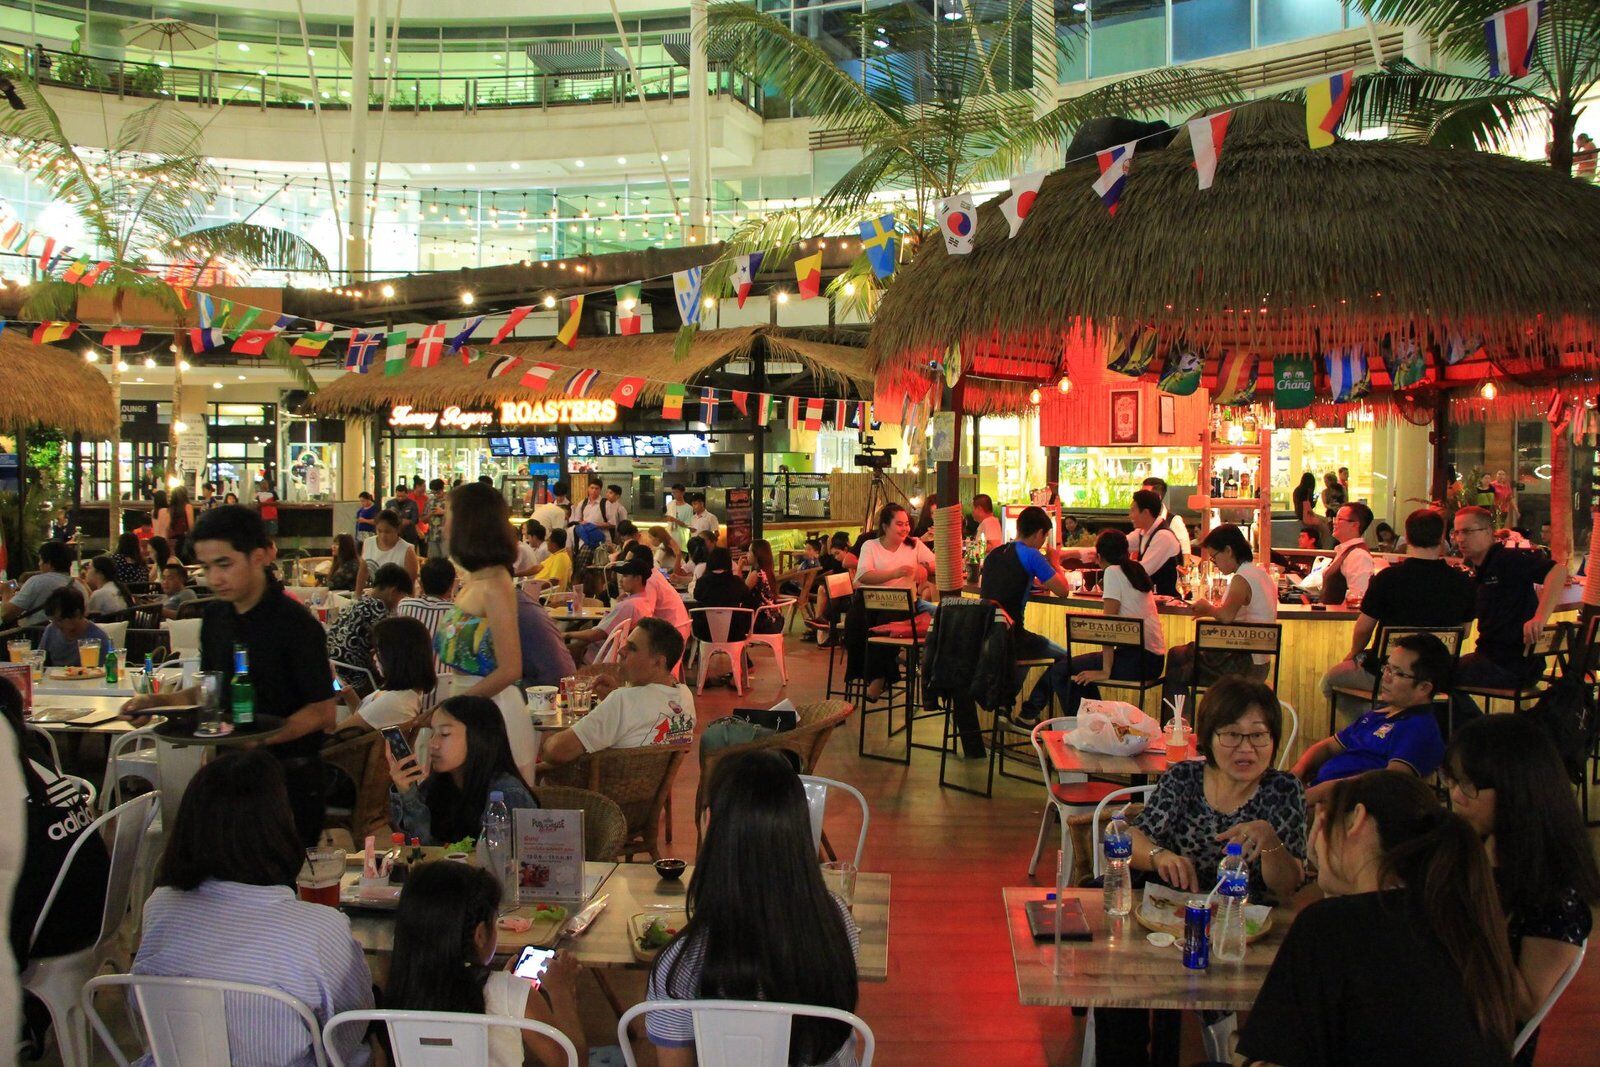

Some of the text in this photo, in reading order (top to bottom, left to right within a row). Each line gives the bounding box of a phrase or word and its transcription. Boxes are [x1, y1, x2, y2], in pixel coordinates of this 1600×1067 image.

[1277, 380, 1311, 392] Chang
[120, 404, 148, 413] OUNGE
[389, 400, 617, 430] Kenny Rogers ROASTERS
[1088, 622, 1140, 634] BAMBOO
[1219, 629, 1276, 640] BAMBOO
[47, 805, 96, 840] adida
